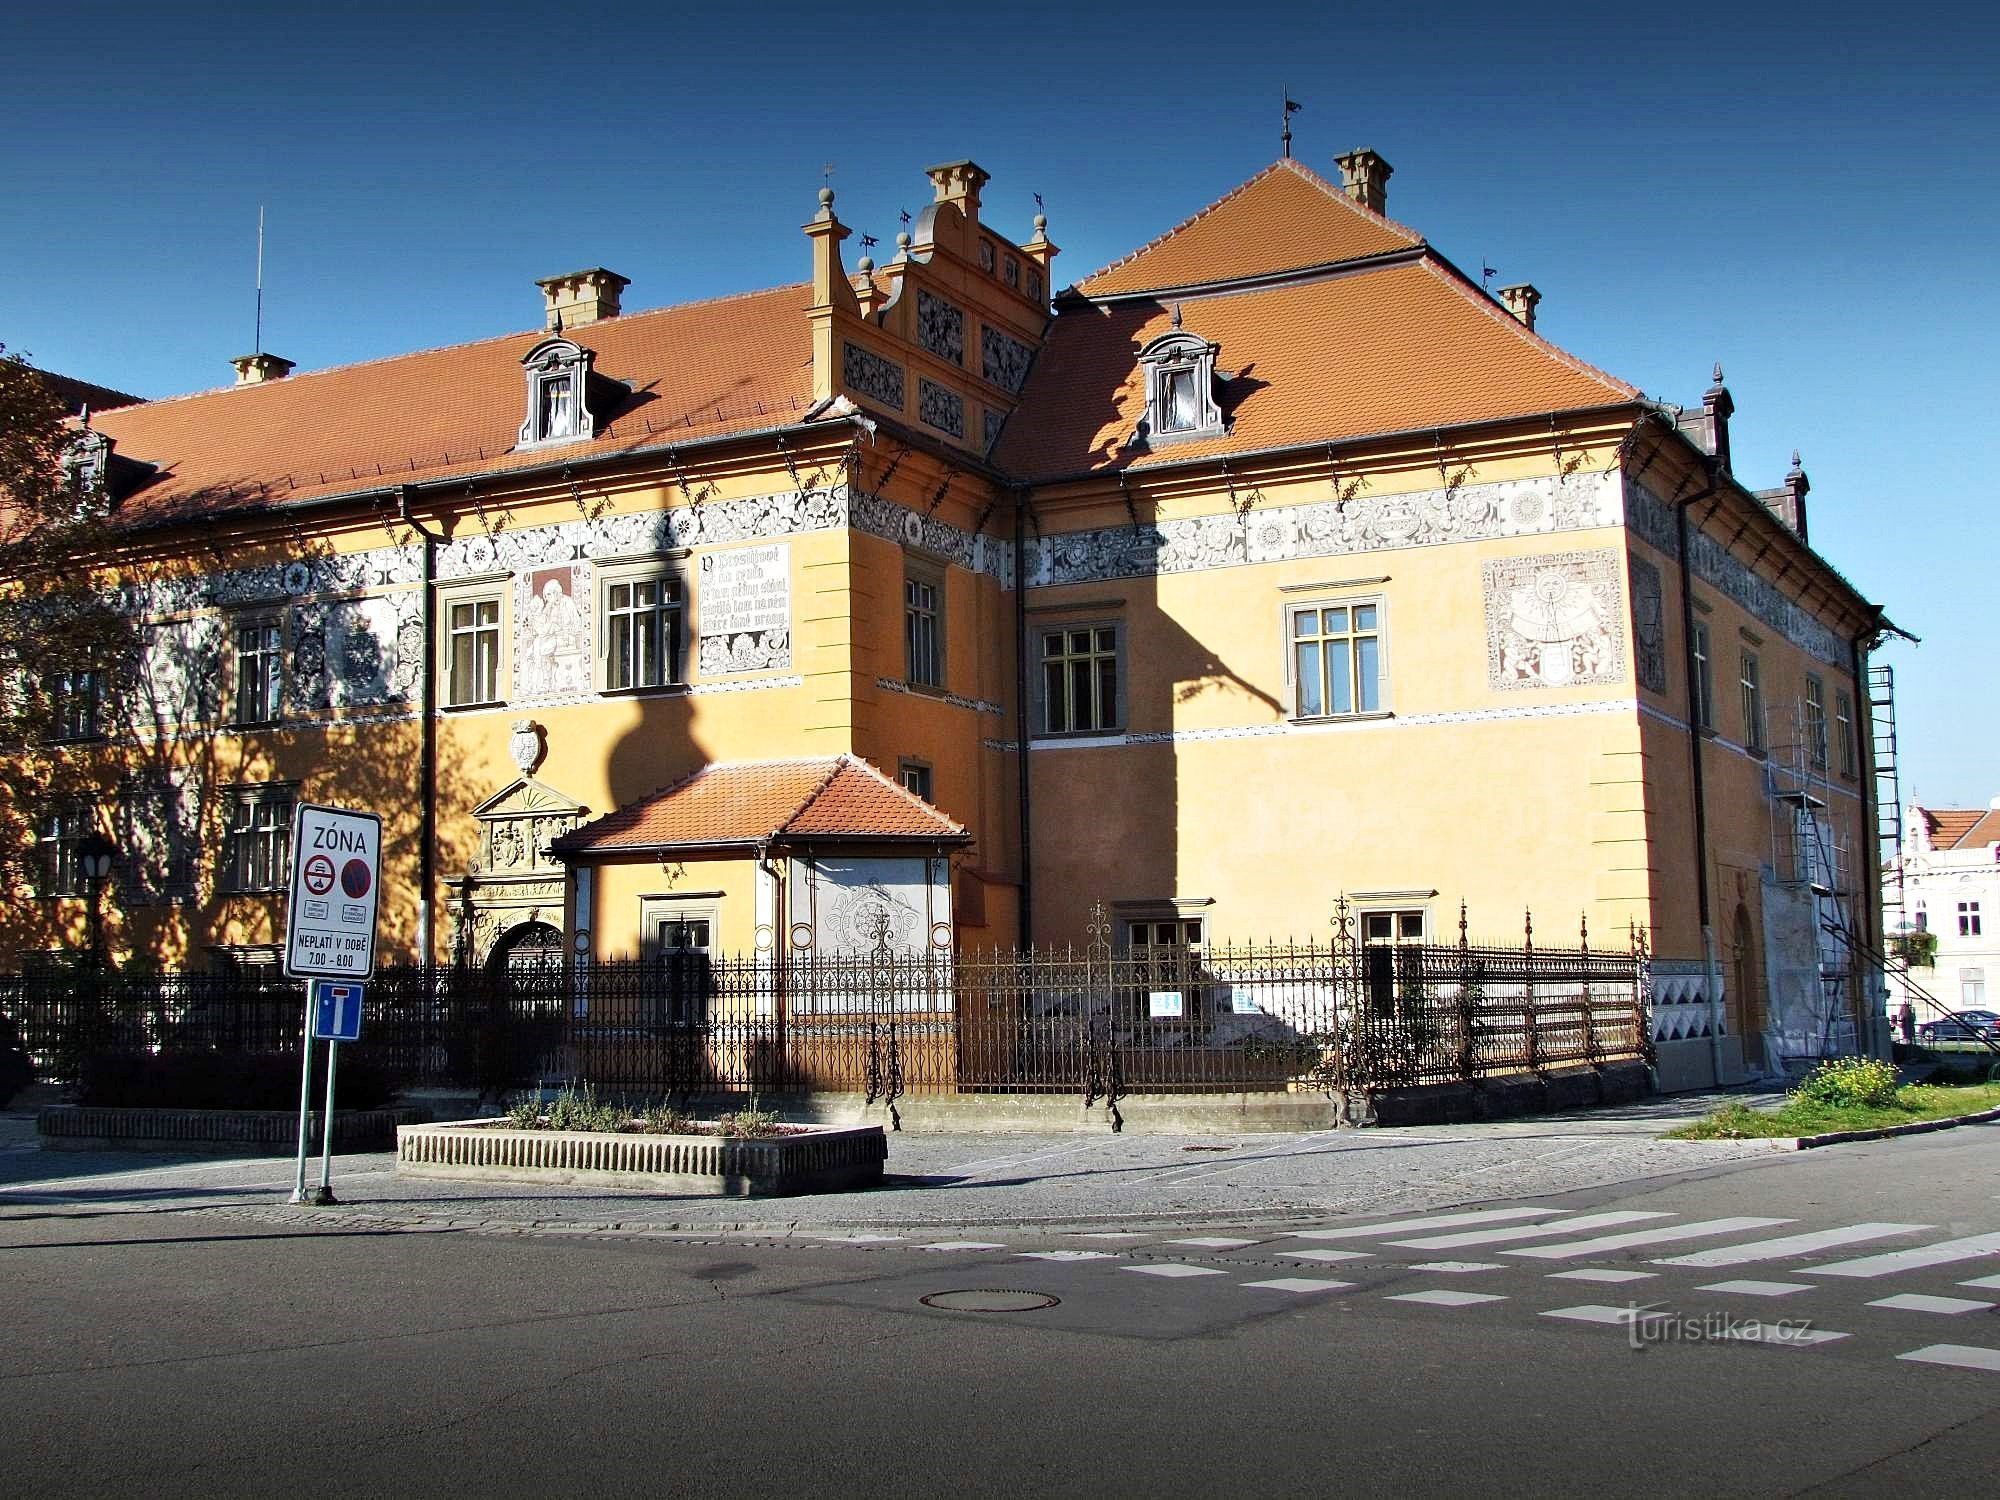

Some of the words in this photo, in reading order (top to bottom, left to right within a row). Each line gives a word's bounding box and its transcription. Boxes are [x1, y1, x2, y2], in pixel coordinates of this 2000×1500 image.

[313, 821, 367, 854] ZÓNA
[298, 934, 333, 949] NEPLATÍ
[336, 938, 342, 949] V
[345, 937, 367, 951] DOBĚ
